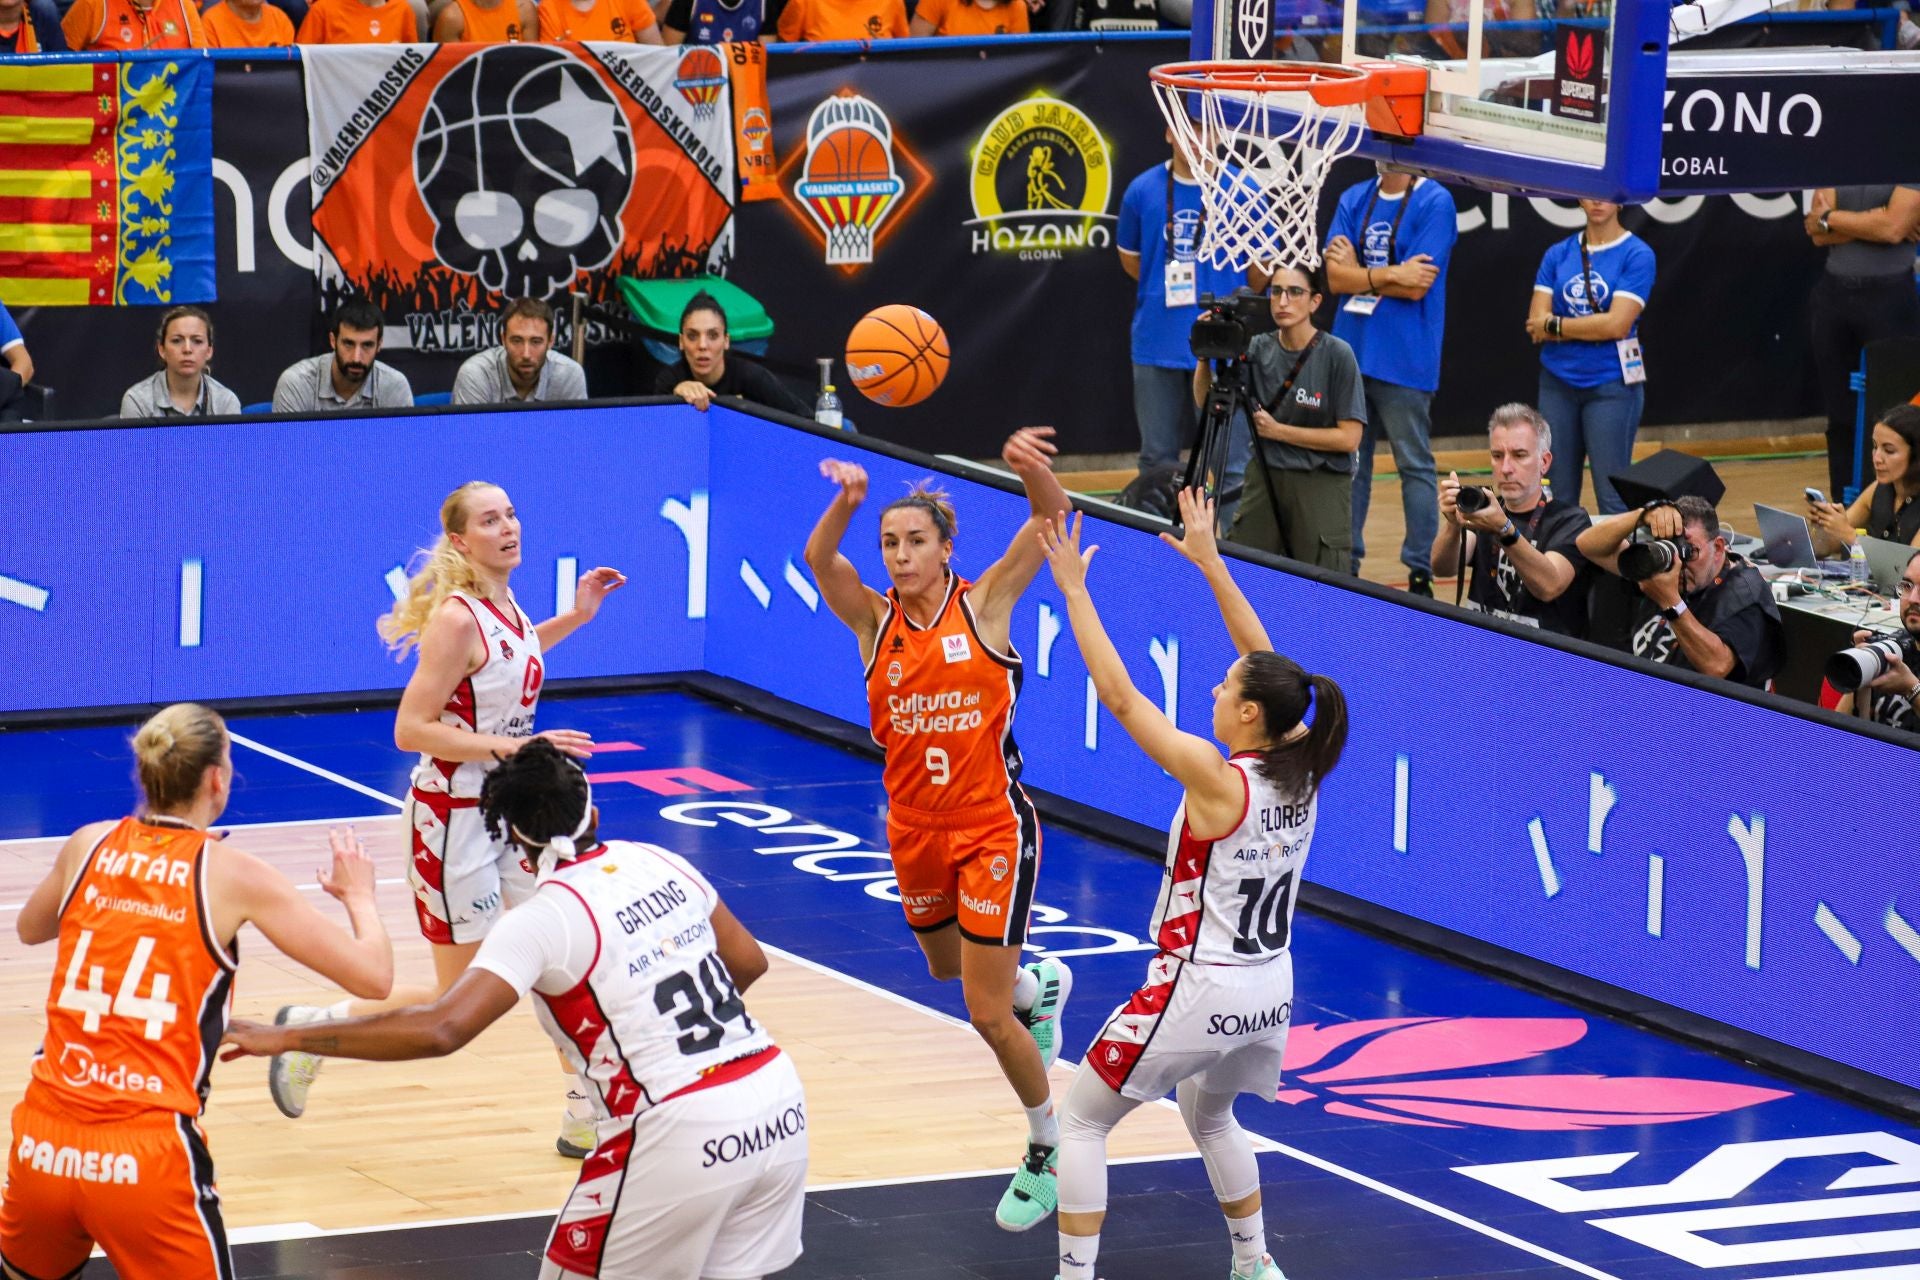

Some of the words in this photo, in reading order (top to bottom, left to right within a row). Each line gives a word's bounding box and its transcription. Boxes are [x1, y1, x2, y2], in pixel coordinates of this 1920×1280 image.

[313, 47, 424, 187] @VALENCIAROSKIS
[602, 50, 723, 183] #SERROSKIMOLA
[977, 111, 1024, 176] CLUB
[1033, 104, 1103, 169] JAIRIS
[804, 183, 853, 195] VALENCIA
[855, 181, 894, 194] BASKET
[971, 223, 1110, 254] HOZONO
[1018, 249, 1063, 261] GLOBAL
[887, 691, 962, 714] Cultura
[963, 692, 980, 707] del
[889, 709, 982, 735] Esfuerzo
[925, 747, 950, 785] 9
[1261, 803, 1309, 833] FLORES
[1233, 848, 1258, 861] AIR
[616, 880, 687, 935] GATLING
[960, 889, 1001, 916] Vitaldin
[1232, 868, 1294, 955] 10
[57, 929, 178, 1041] 44
[628, 954, 653, 978] AIR
[653, 952, 756, 1056] 34
[702, 1102, 805, 1168] SOMMOS
[17, 1133, 139, 1185] PAMESA
